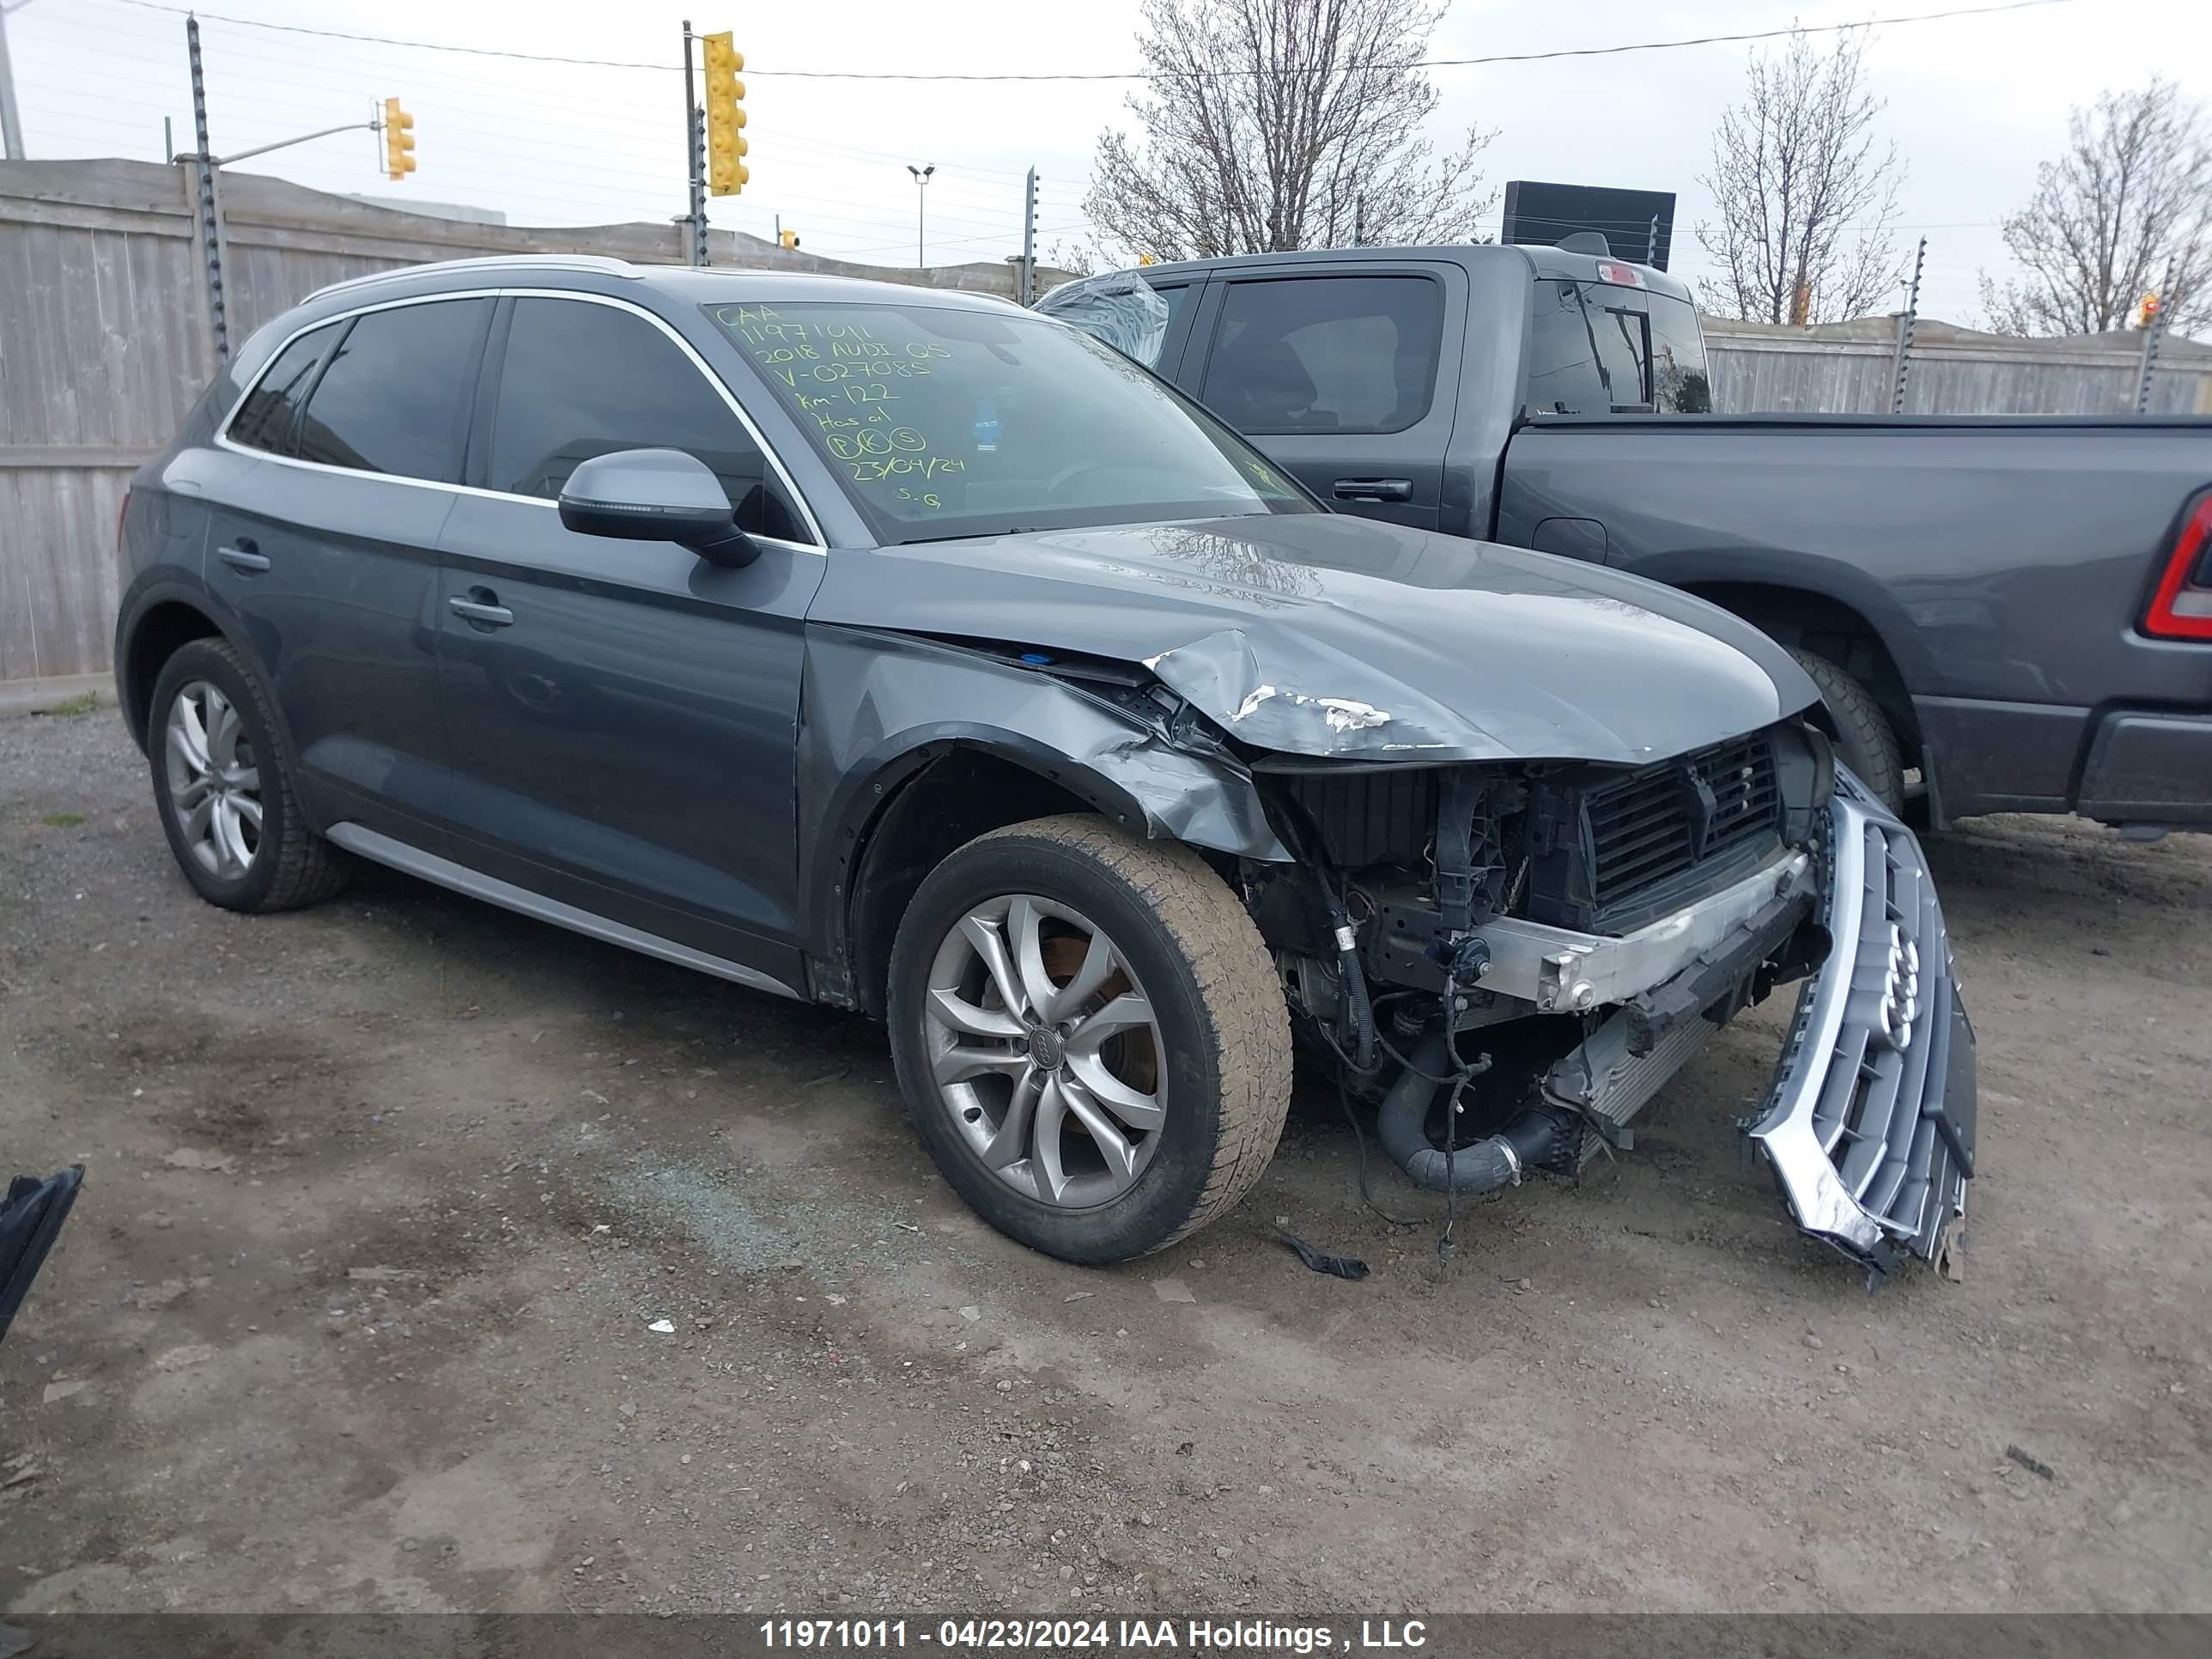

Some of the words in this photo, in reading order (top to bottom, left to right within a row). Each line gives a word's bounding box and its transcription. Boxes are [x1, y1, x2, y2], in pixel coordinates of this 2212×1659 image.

[716, 305, 783, 326] CAA
[741, 323, 872, 344] 11971011
[755, 344, 820, 363] 2018
[831, 342, 897, 357] AUDI
[906, 343, 951, 358] Q5
[846, 457, 965, 481] 23/04/24
